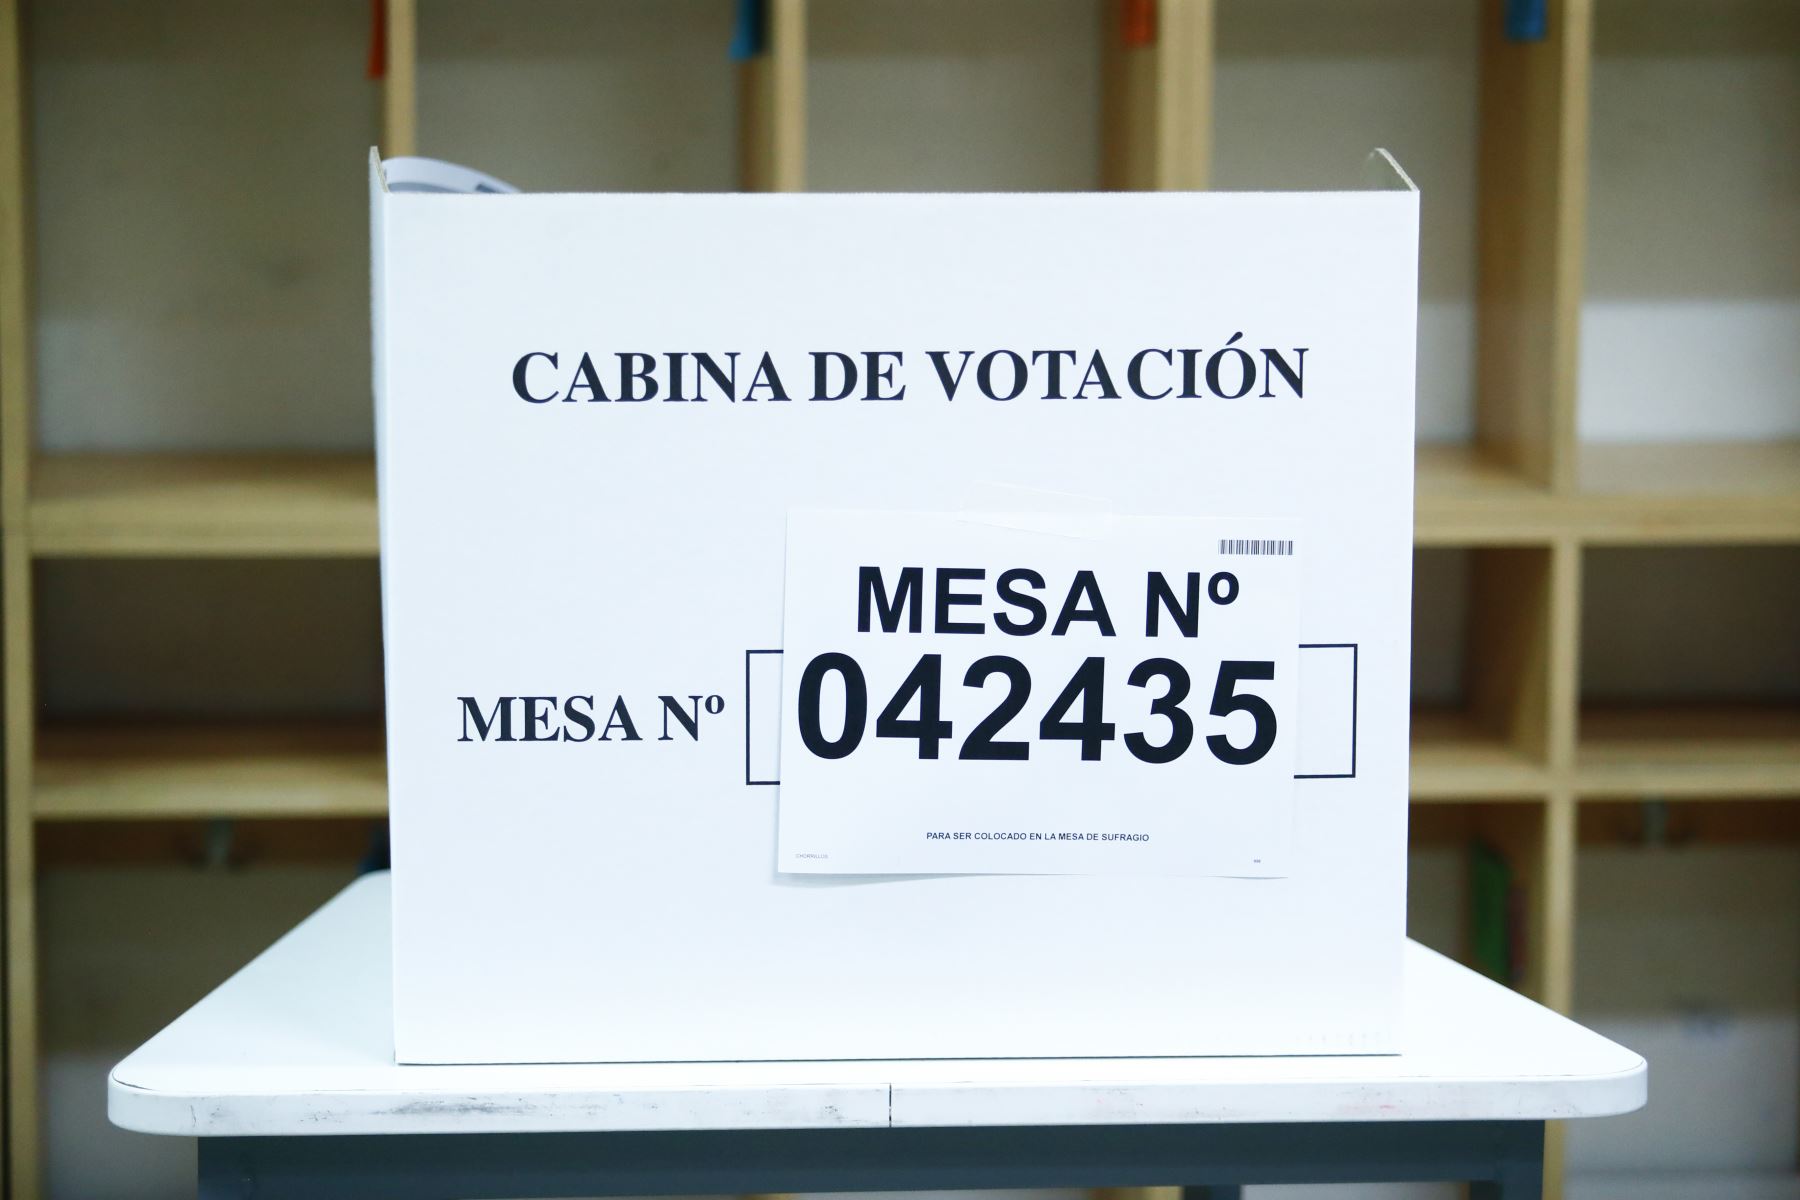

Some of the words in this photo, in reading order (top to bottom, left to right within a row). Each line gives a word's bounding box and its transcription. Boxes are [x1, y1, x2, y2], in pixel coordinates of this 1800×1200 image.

[513, 351, 791, 404] CABINA
[809, 351, 906, 402] DE
[925, 331, 1310, 402] VOTACIÓN
[857, 565, 1117, 637] MESA
[1145, 571, 1240, 638] Nº
[457, 694, 644, 743] MESA
[657, 694, 725, 742] Nº
[797, 651, 1278, 766] 042435
[926, 831, 951, 840] PARA
[952, 831, 972, 840] SER
[973, 832, 1028, 841] COLOCADO
[1029, 832, 1042, 841] EN
[1044, 832, 1057, 841] LA
[1058, 832, 1085, 841] MESA
[1086, 832, 1099, 841] DE
[1101, 832, 1150, 842] SUFRAGIO
